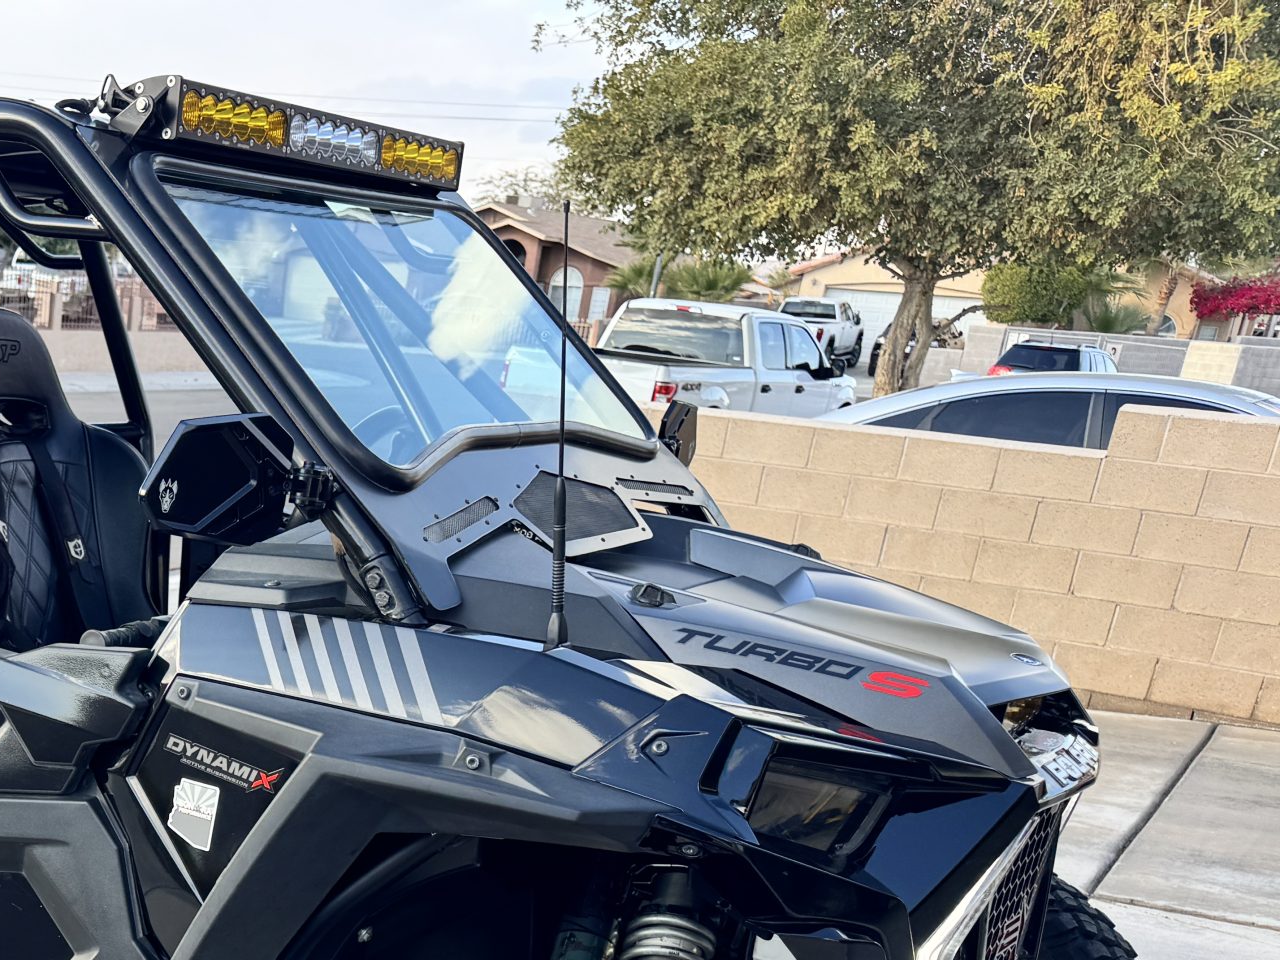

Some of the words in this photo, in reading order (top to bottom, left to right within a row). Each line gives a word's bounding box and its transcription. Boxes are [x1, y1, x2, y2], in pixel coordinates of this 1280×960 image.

[675, 627, 866, 680] TURBO
[859, 670, 931, 699] S
[166, 736, 280, 790] DYNAMIX
[206, 767, 249, 788] SUSPENSION
